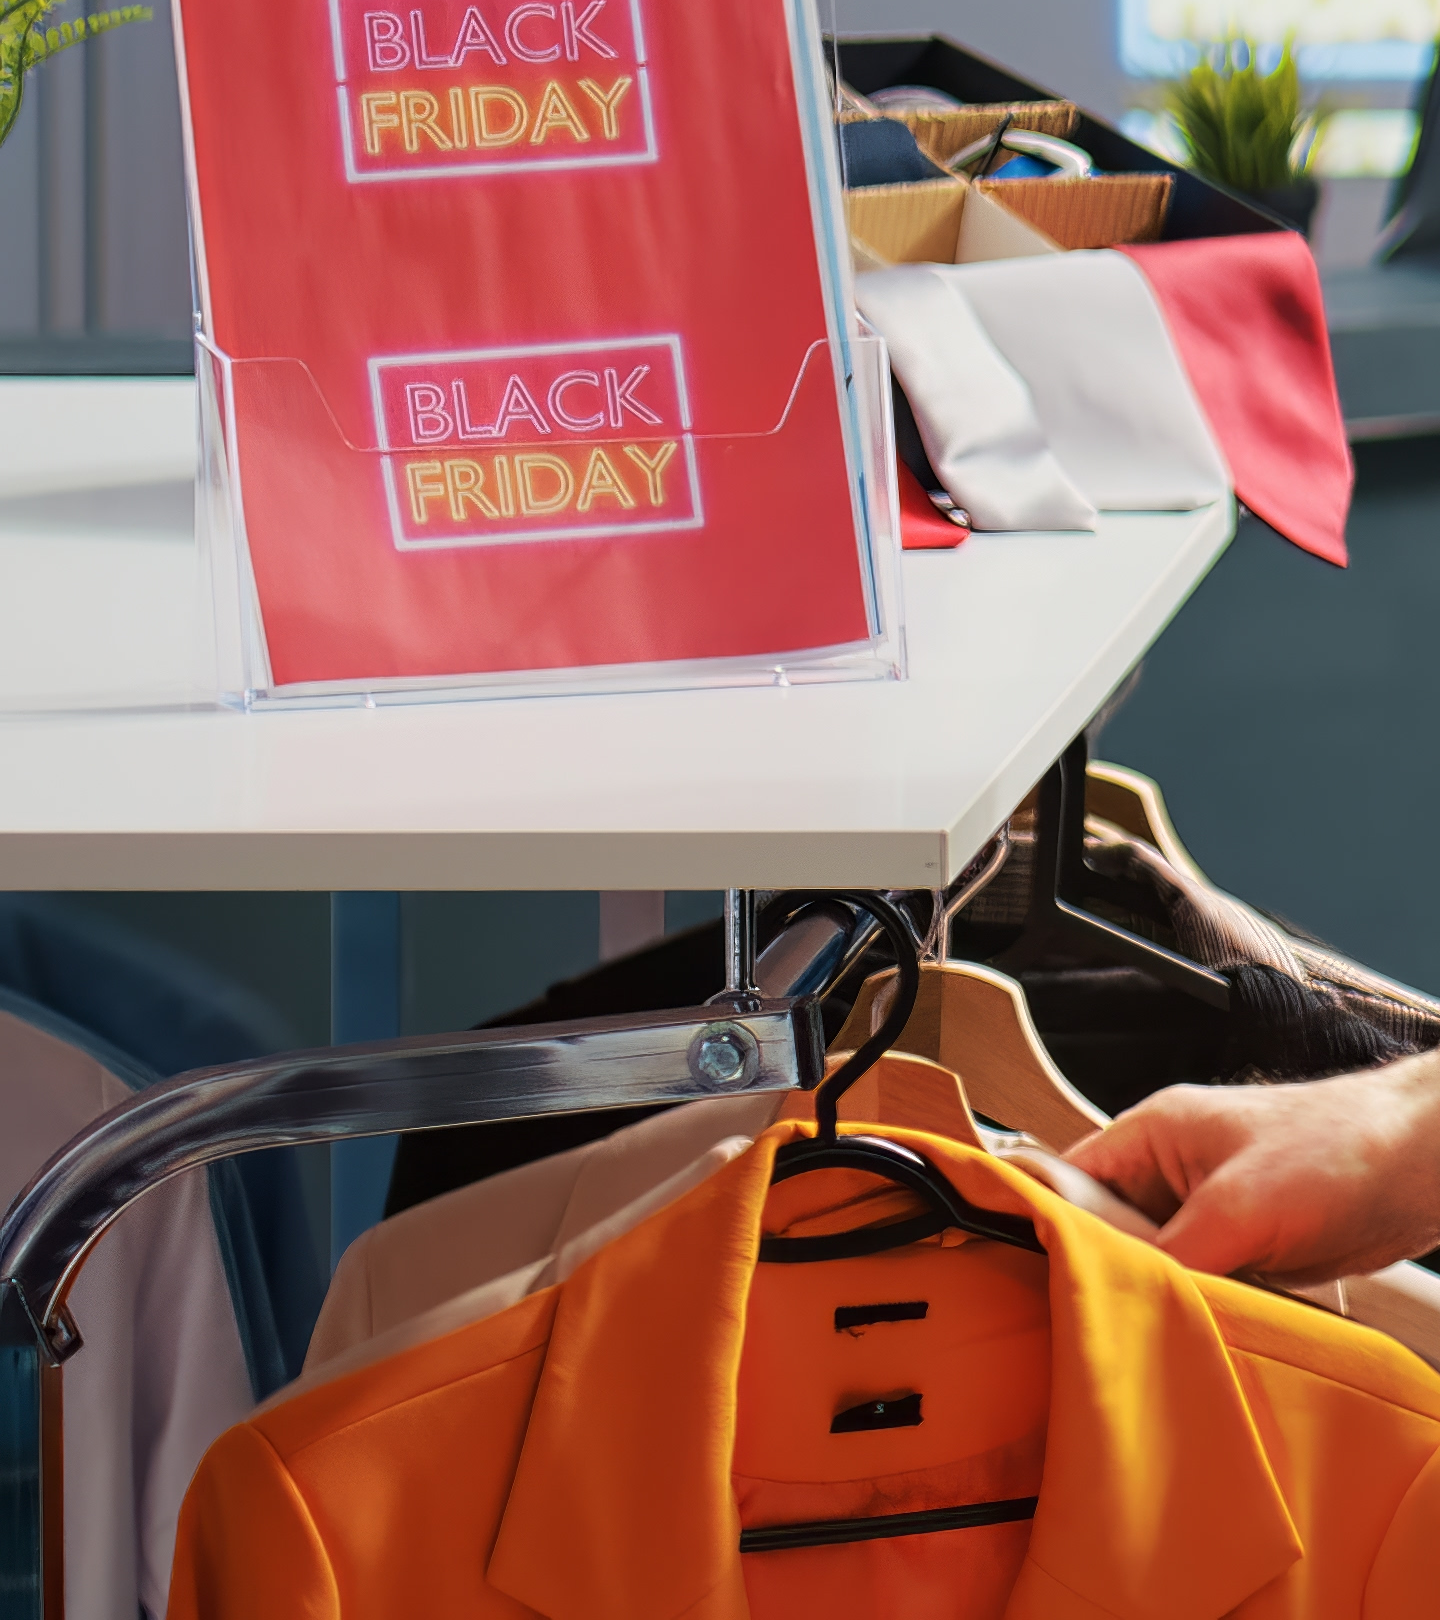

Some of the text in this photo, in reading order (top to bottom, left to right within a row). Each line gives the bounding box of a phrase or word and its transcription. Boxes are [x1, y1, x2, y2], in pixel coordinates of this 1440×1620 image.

[361, 77, 632, 156] FRIDAY
[405, 364, 663, 444] BLACK
[405, 440, 677, 525] FRIDAY
